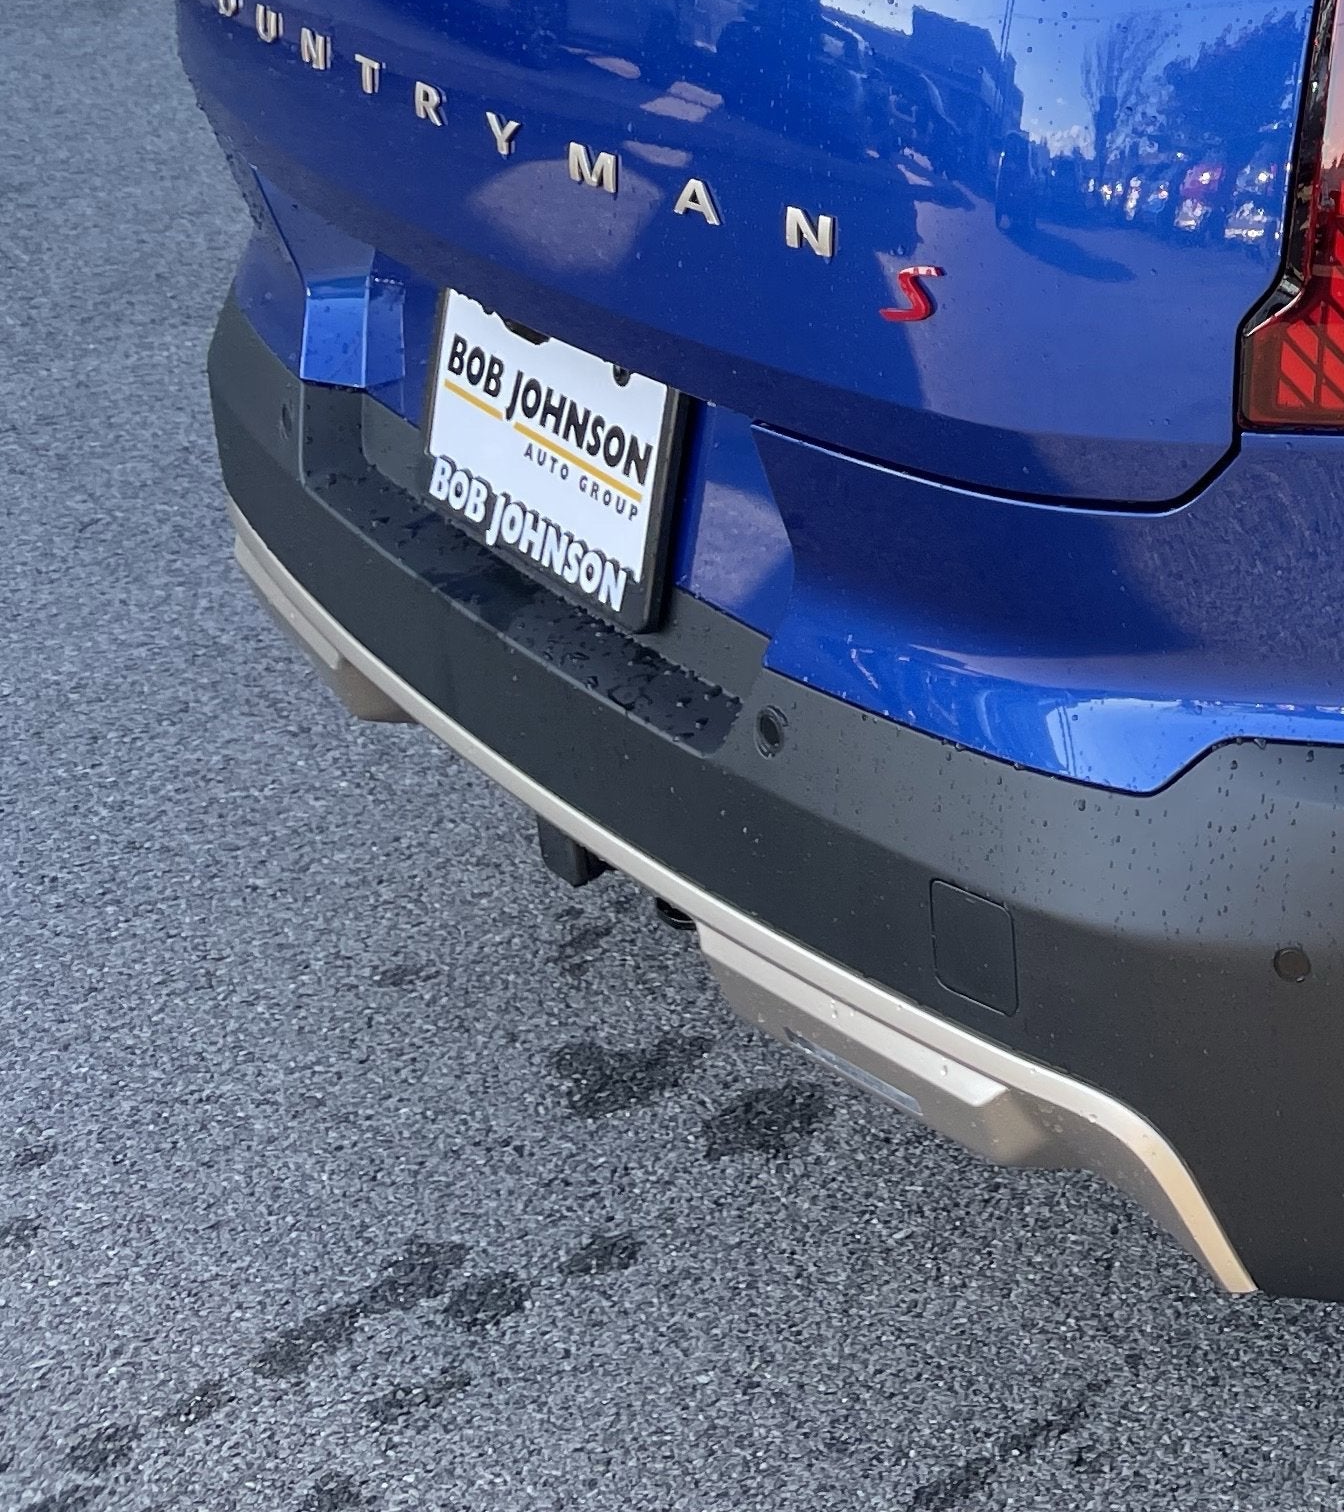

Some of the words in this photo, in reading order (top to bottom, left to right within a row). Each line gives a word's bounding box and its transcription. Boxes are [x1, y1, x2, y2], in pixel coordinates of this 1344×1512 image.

[879, 265, 946, 322] S
[446, 333, 506, 398] BOB
[505, 369, 654, 486] JOHNSON
[429, 457, 489, 524] BOB
[485, 492, 628, 613] JOHNSON
[523, 442, 570, 481] AUTO
[578, 474, 639, 521] GROUP
